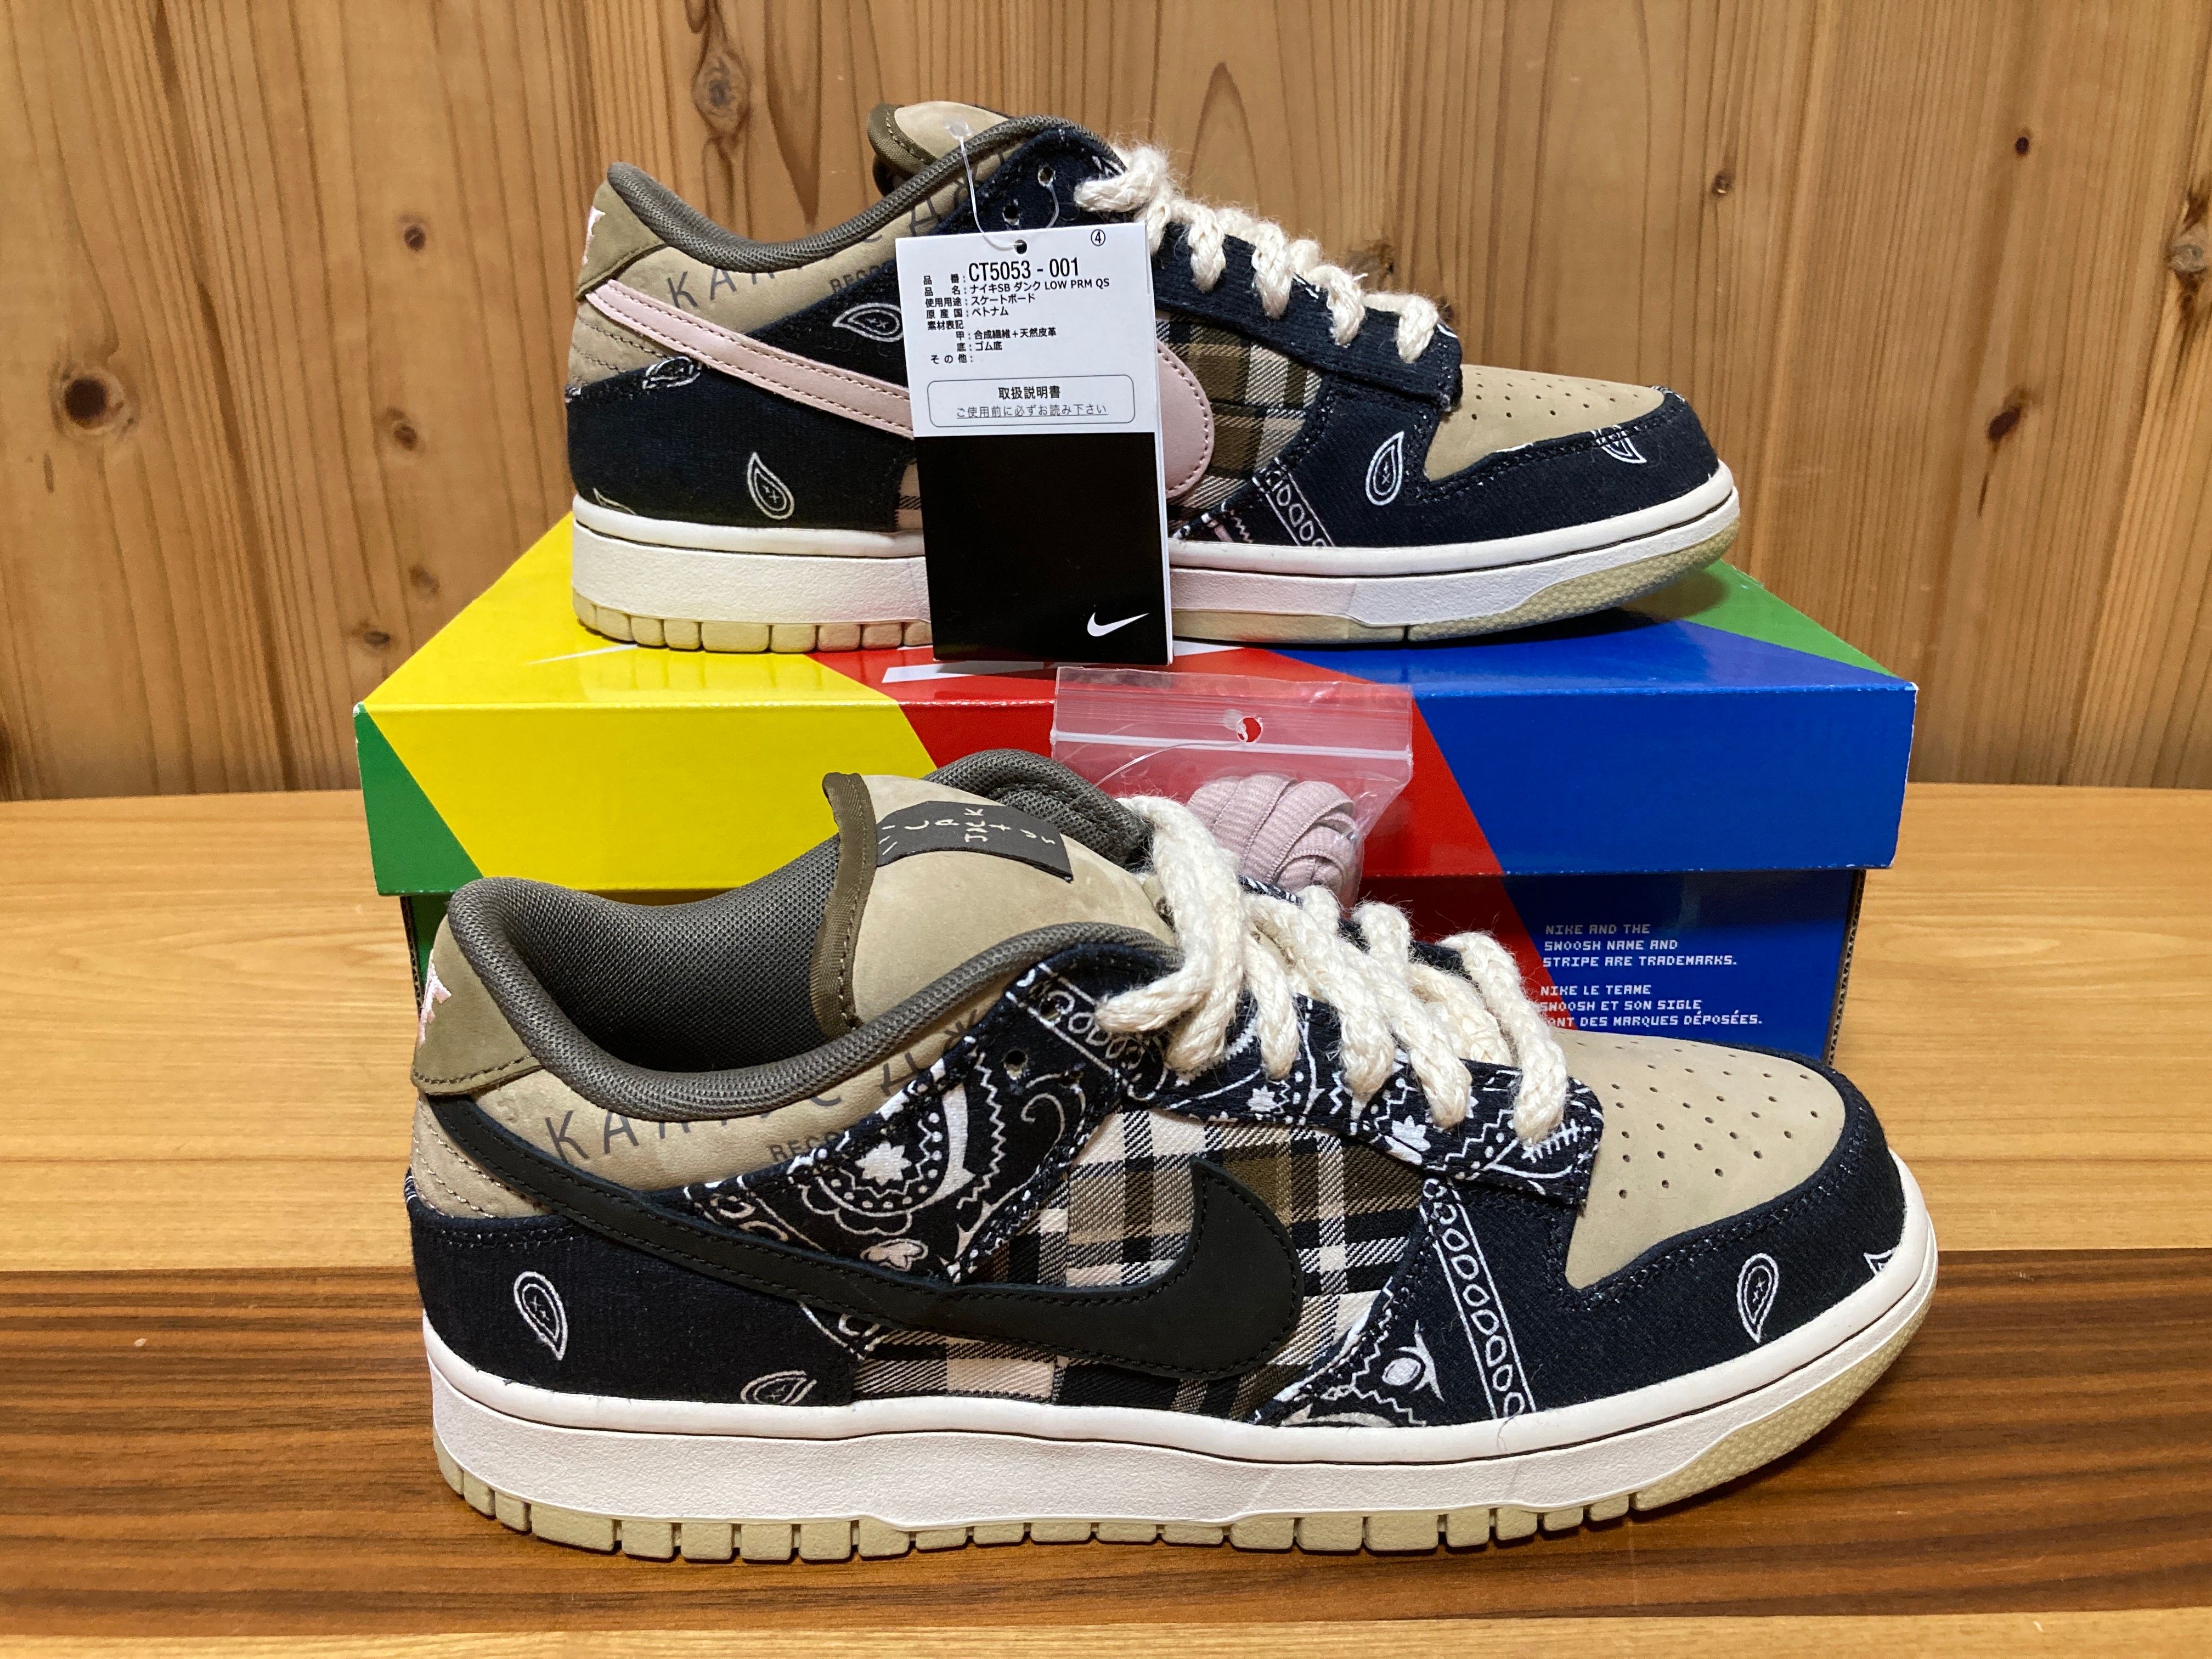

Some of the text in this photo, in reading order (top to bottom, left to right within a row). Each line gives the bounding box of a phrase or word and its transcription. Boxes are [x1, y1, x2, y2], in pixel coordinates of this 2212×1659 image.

[969, 261, 1031, 281] CT5053
[1049, 257, 1078, 277] 001
[1045, 280, 1066, 290] LOW
[1071, 279, 1092, 288] PRM
[1096, 278, 1109, 289] QS
[998, 386, 1060, 399] 取扱説明書
[956, 404, 1107, 419] ご使用前に必ずお読み下さい
[1545, 924, 1650, 935] NIKE AND THE
[1545, 940, 1677, 951] SWOOSH NAME AND
[1543, 955, 1736, 967] STRIPE ARE TRADEMARKS.
[1541, 986, 1577, 996] NIKE
[1584, 986, 1599, 995] LE
[1601, 1001, 1618, 1011] ET
[1624, 1001, 1651, 1010] SON
[1657, 1000, 1702, 1010] SIGLE
[1543, 1009, 1763, 1027] ONT DES MARQUES DÉPOSÉES.
